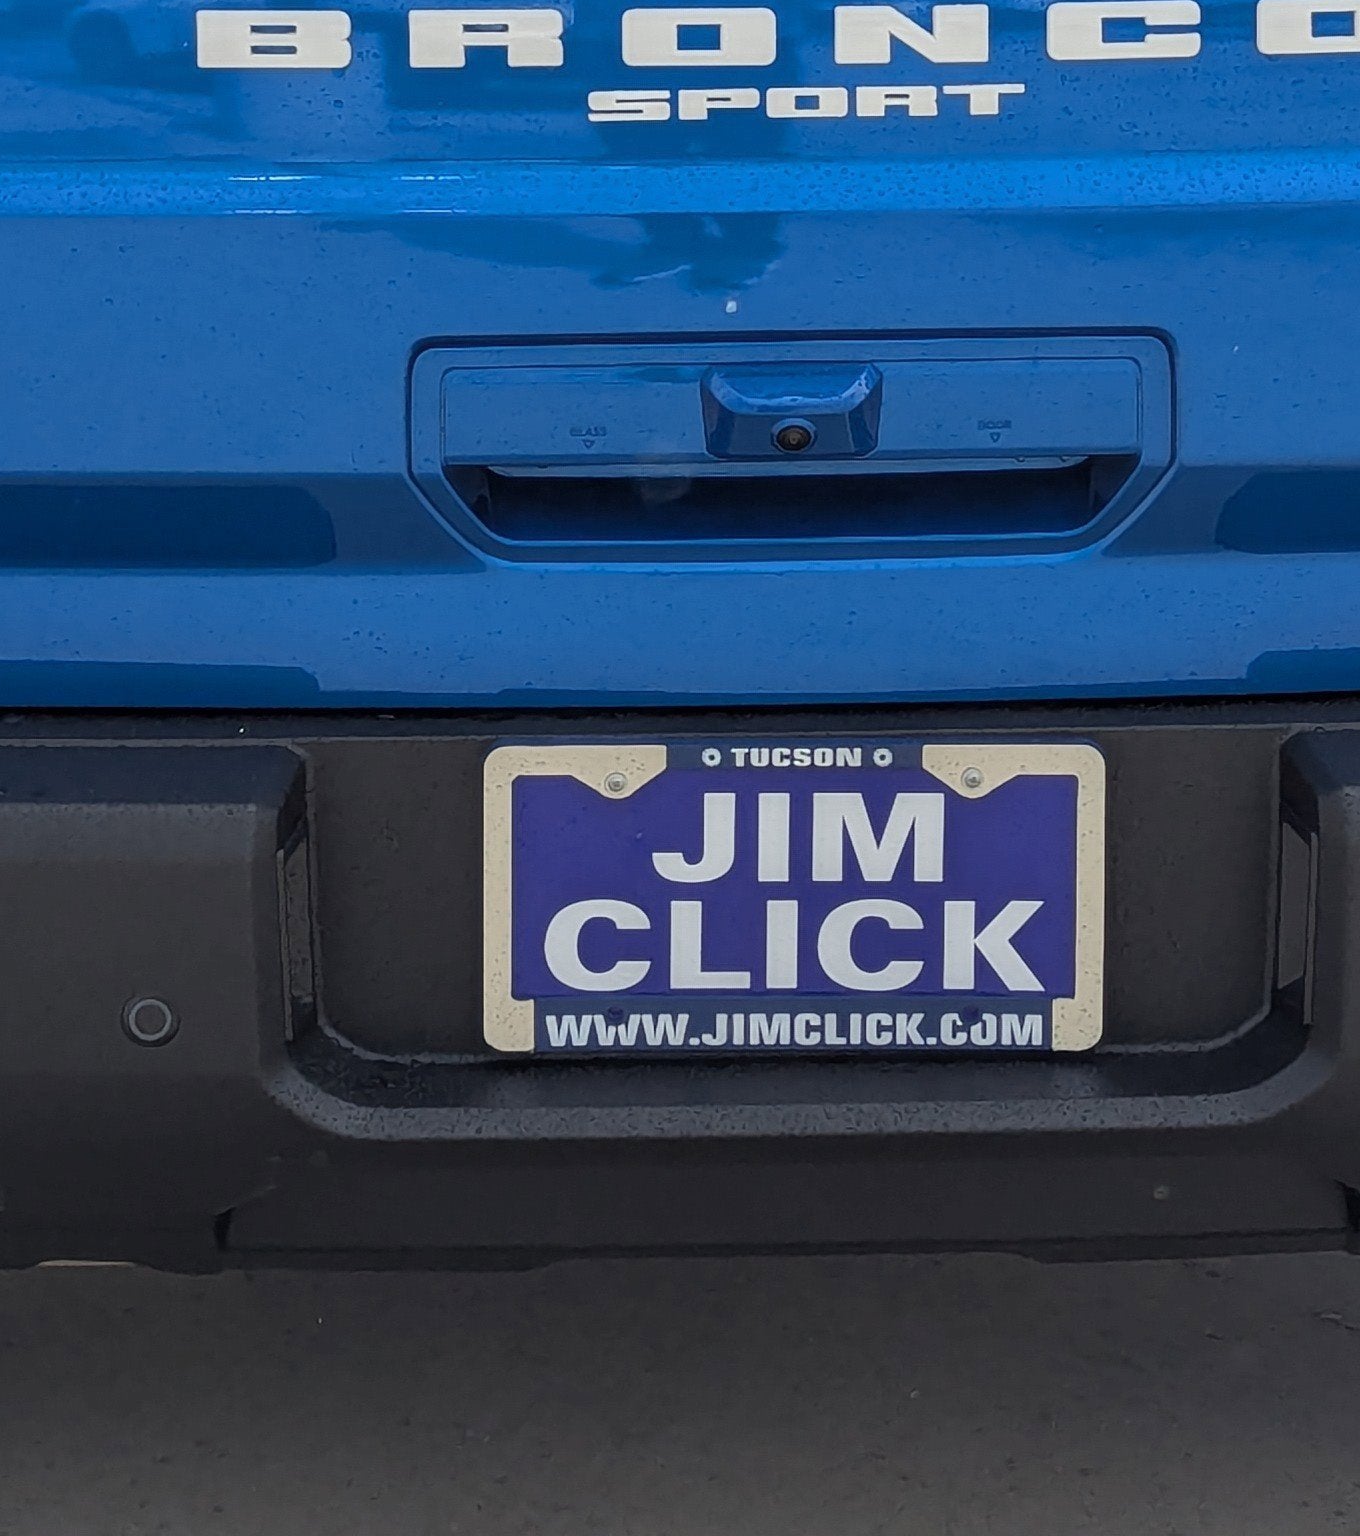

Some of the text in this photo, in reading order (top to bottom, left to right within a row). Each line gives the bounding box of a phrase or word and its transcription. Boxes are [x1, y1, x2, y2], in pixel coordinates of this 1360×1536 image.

[587, 83, 1026, 122] SPORT
[730, 747, 862, 768] TUCSON
[651, 792, 945, 884] JIM
[543, 898, 1046, 992] CLICK
[545, 1011, 1044, 1048] WWW.JIMCLICK.COM
